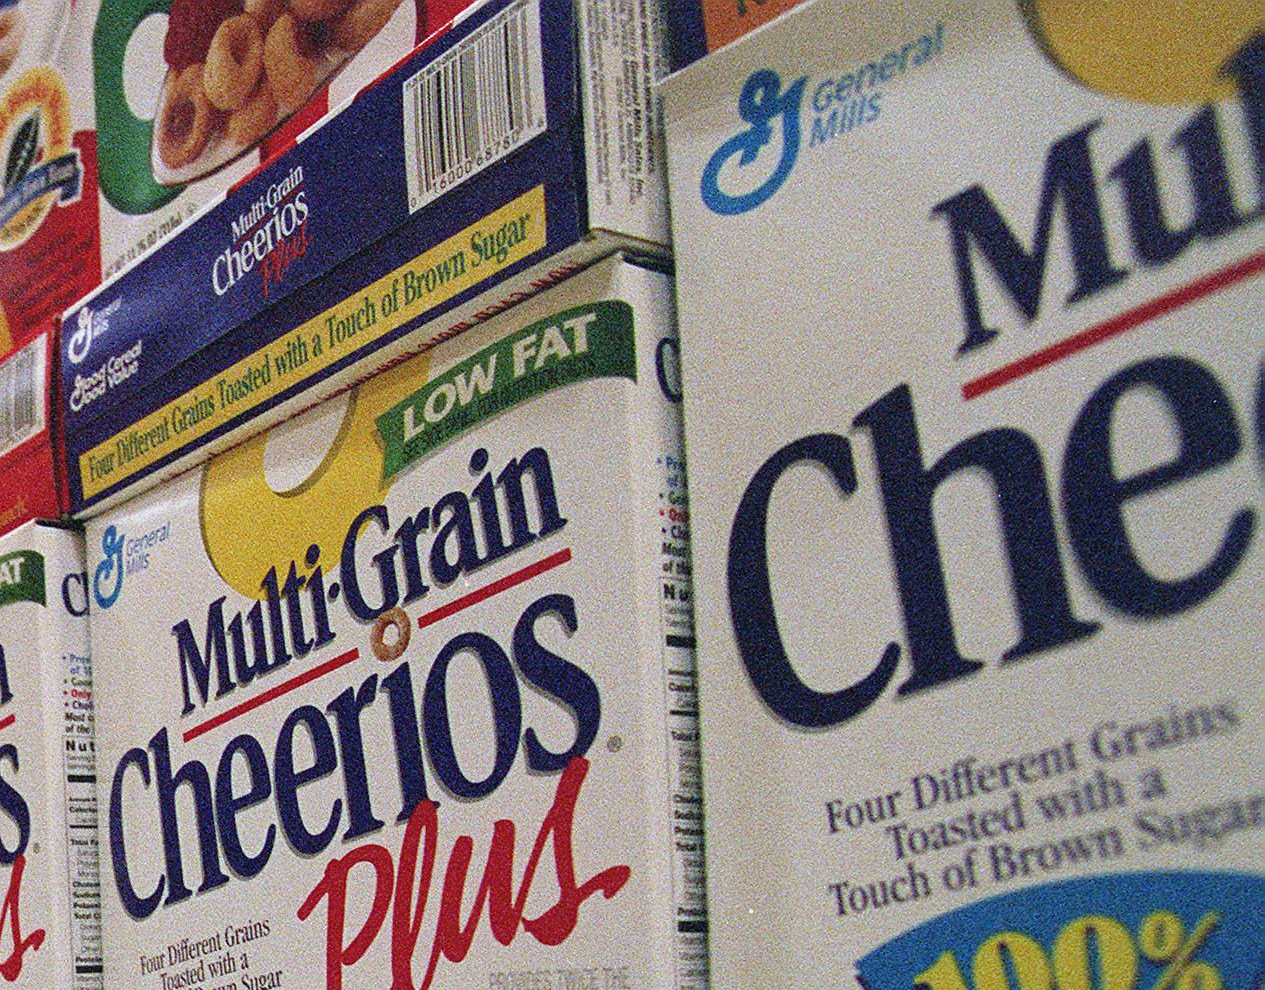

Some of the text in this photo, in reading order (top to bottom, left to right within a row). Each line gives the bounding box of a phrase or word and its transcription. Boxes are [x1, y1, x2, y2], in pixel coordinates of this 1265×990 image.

[812, 20, 946, 113] General
[809, 96, 882, 149] Mills
[212, 191, 309, 296] Cheerios
[88, 212, 532, 483] Four Different Grains Toasted with a Touch of Brown Sugar
[403, 352, 498, 444] LOW
[512, 311, 598, 378] FAT
[126, 521, 171, 558] General
[726, 354, 1265, 735] Che
[108, 593, 601, 919] Cheerios
[825, 700, 1241, 836] Four Different Grains
[828, 795, 1265, 917] Touch of Brown Sugar
[885, 768, 1168, 862] Toasted with a
[139, 918, 272, 977] Four Different Grains
[207, 950, 236, 979] with
[240, 953, 250, 970] a
